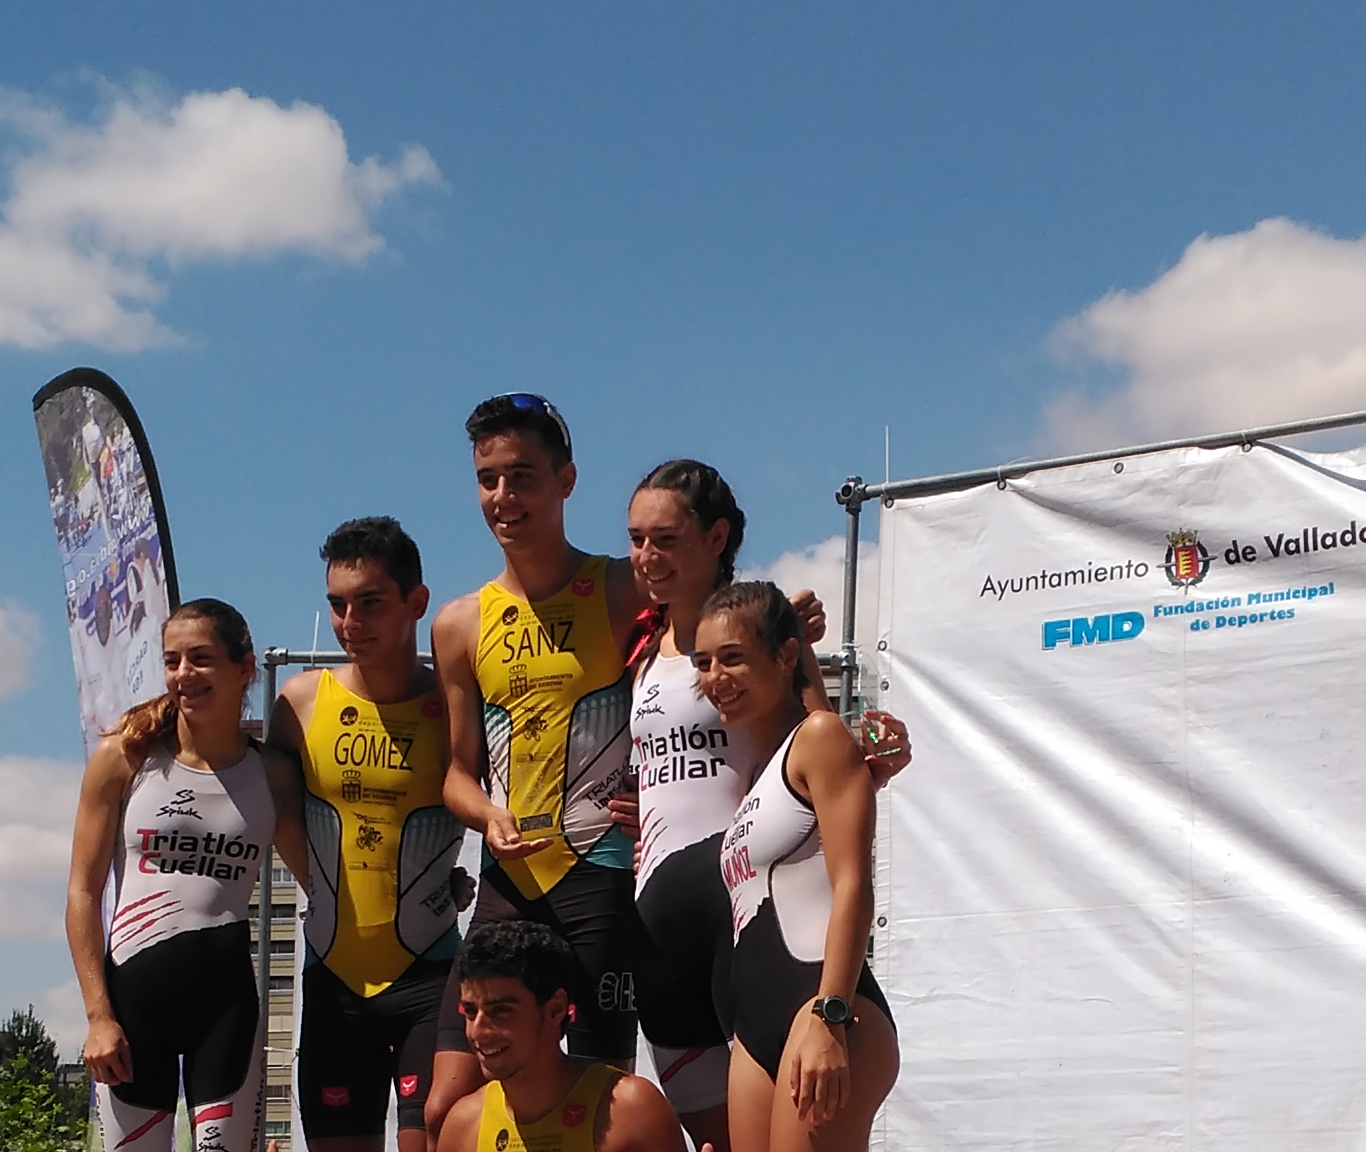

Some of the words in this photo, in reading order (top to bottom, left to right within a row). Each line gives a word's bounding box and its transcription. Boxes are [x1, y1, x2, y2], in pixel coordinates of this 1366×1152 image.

[980, 559, 1149, 601] Ayuntamiento
[1225, 538, 1257, 566] de
[1153, 595, 1242, 617] Fundación
[1248, 581, 1335, 605] Municipal
[1041, 610, 1146, 650] FMD
[1189, 616, 1211, 632] de
[1216, 607, 1295, 630] Deportes
[502, 620, 575, 664] SANZ
[335, 732, 413, 770] GOMEZ
[634, 724, 728, 764] Triatlón
[641, 756, 725, 791] Cuéllar
[156, 806, 202, 820] Spiuk
[137, 829, 259, 860] Triatlón
[139, 852, 246, 880] Cuéllar
